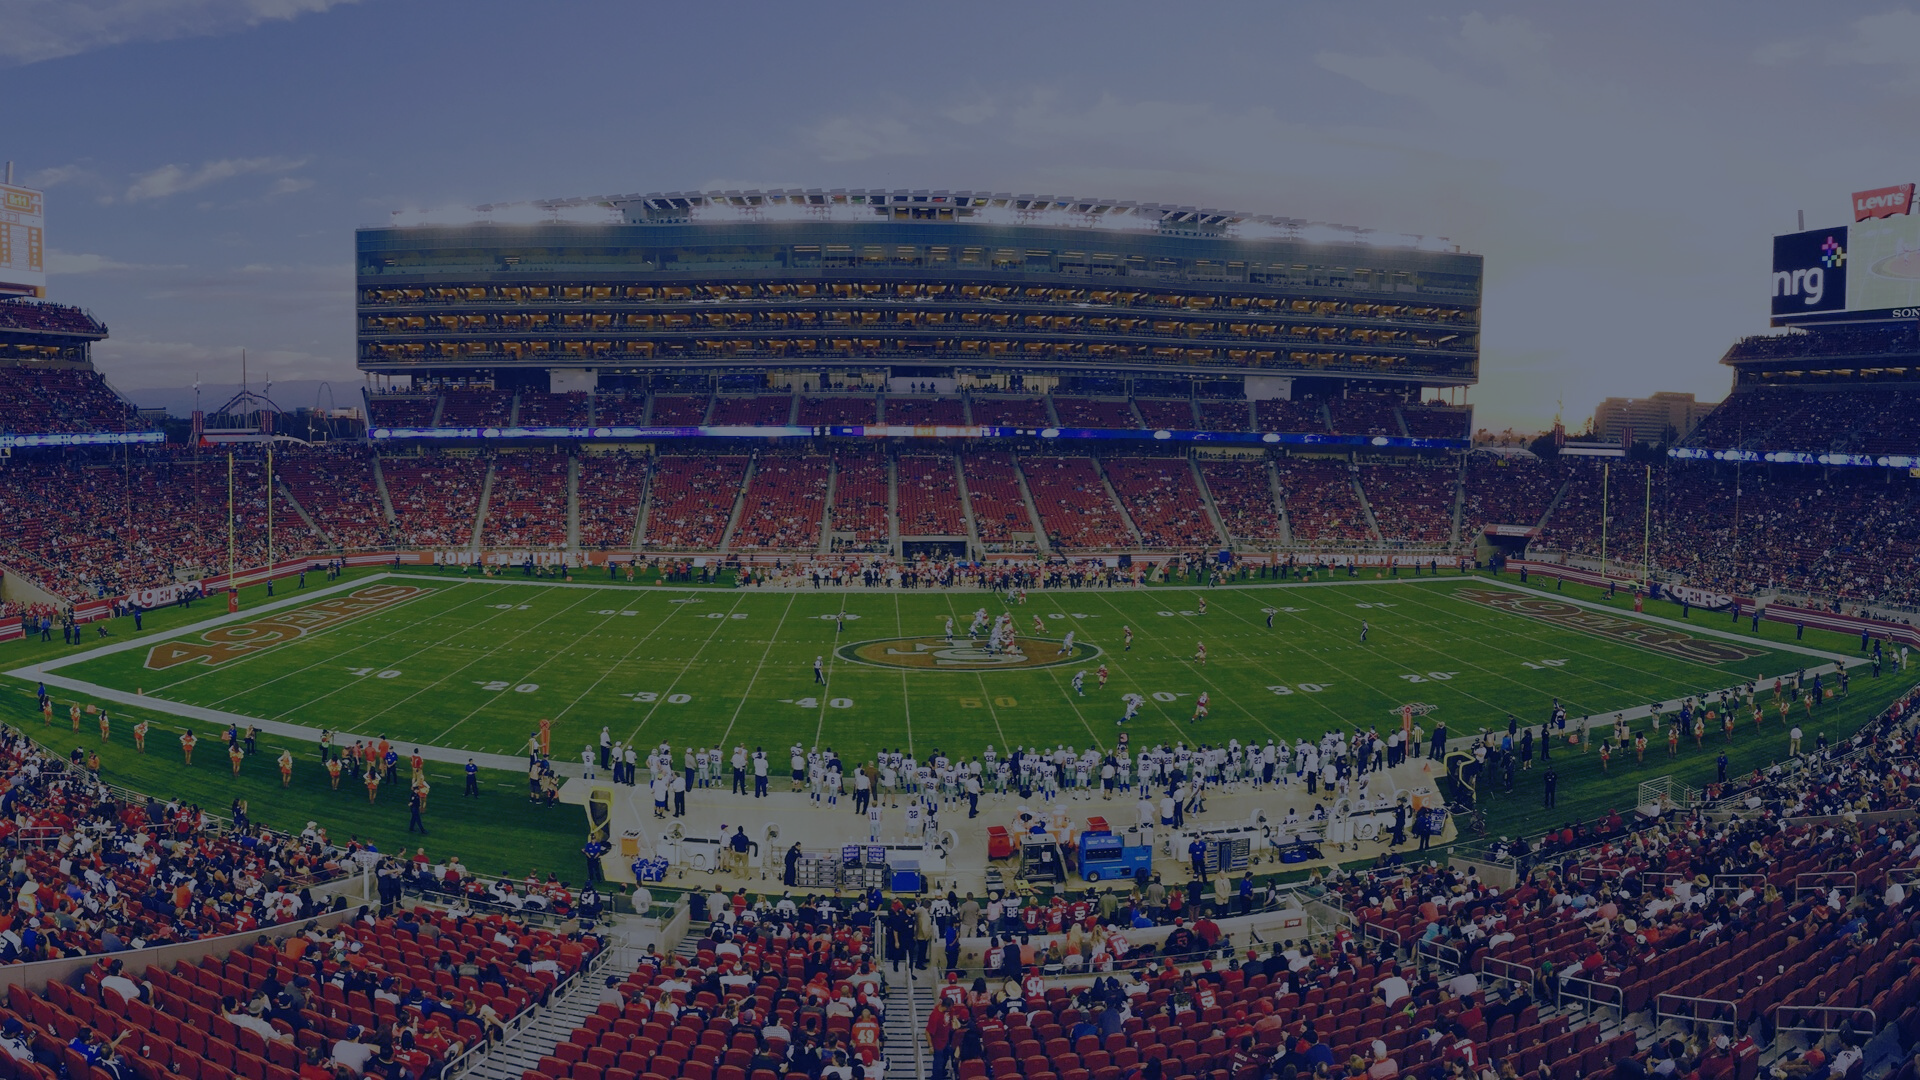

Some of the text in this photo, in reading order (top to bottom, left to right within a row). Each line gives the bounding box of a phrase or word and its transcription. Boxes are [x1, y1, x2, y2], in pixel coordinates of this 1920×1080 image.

[1772, 267, 1824, 305] nrg
[143, 584, 439, 671] 49ERS
[1450, 588, 1770, 665] 49ERS
[1400, 670, 1453, 684] 20
[481, 680, 540, 693] 20
[1266, 683, 1323, 696] 30
[631, 691, 692, 704] 30
[795, 697, 854, 709] 40
[958, 696, 1018, 709] 50
[1421, 797, 1430, 807] G
[870, 811, 878, 820] 11
[908, 810, 918, 819] 32
[580, 894, 595, 906] 54
[1006, 906, 1018, 918] 88
[236, 920, 244, 932] 7
[1112, 939, 1129, 956] 16
[1026, 979, 1045, 998] 94
[857, 1029, 875, 1044] 49
[1462, 1046, 1475, 1067] 7
